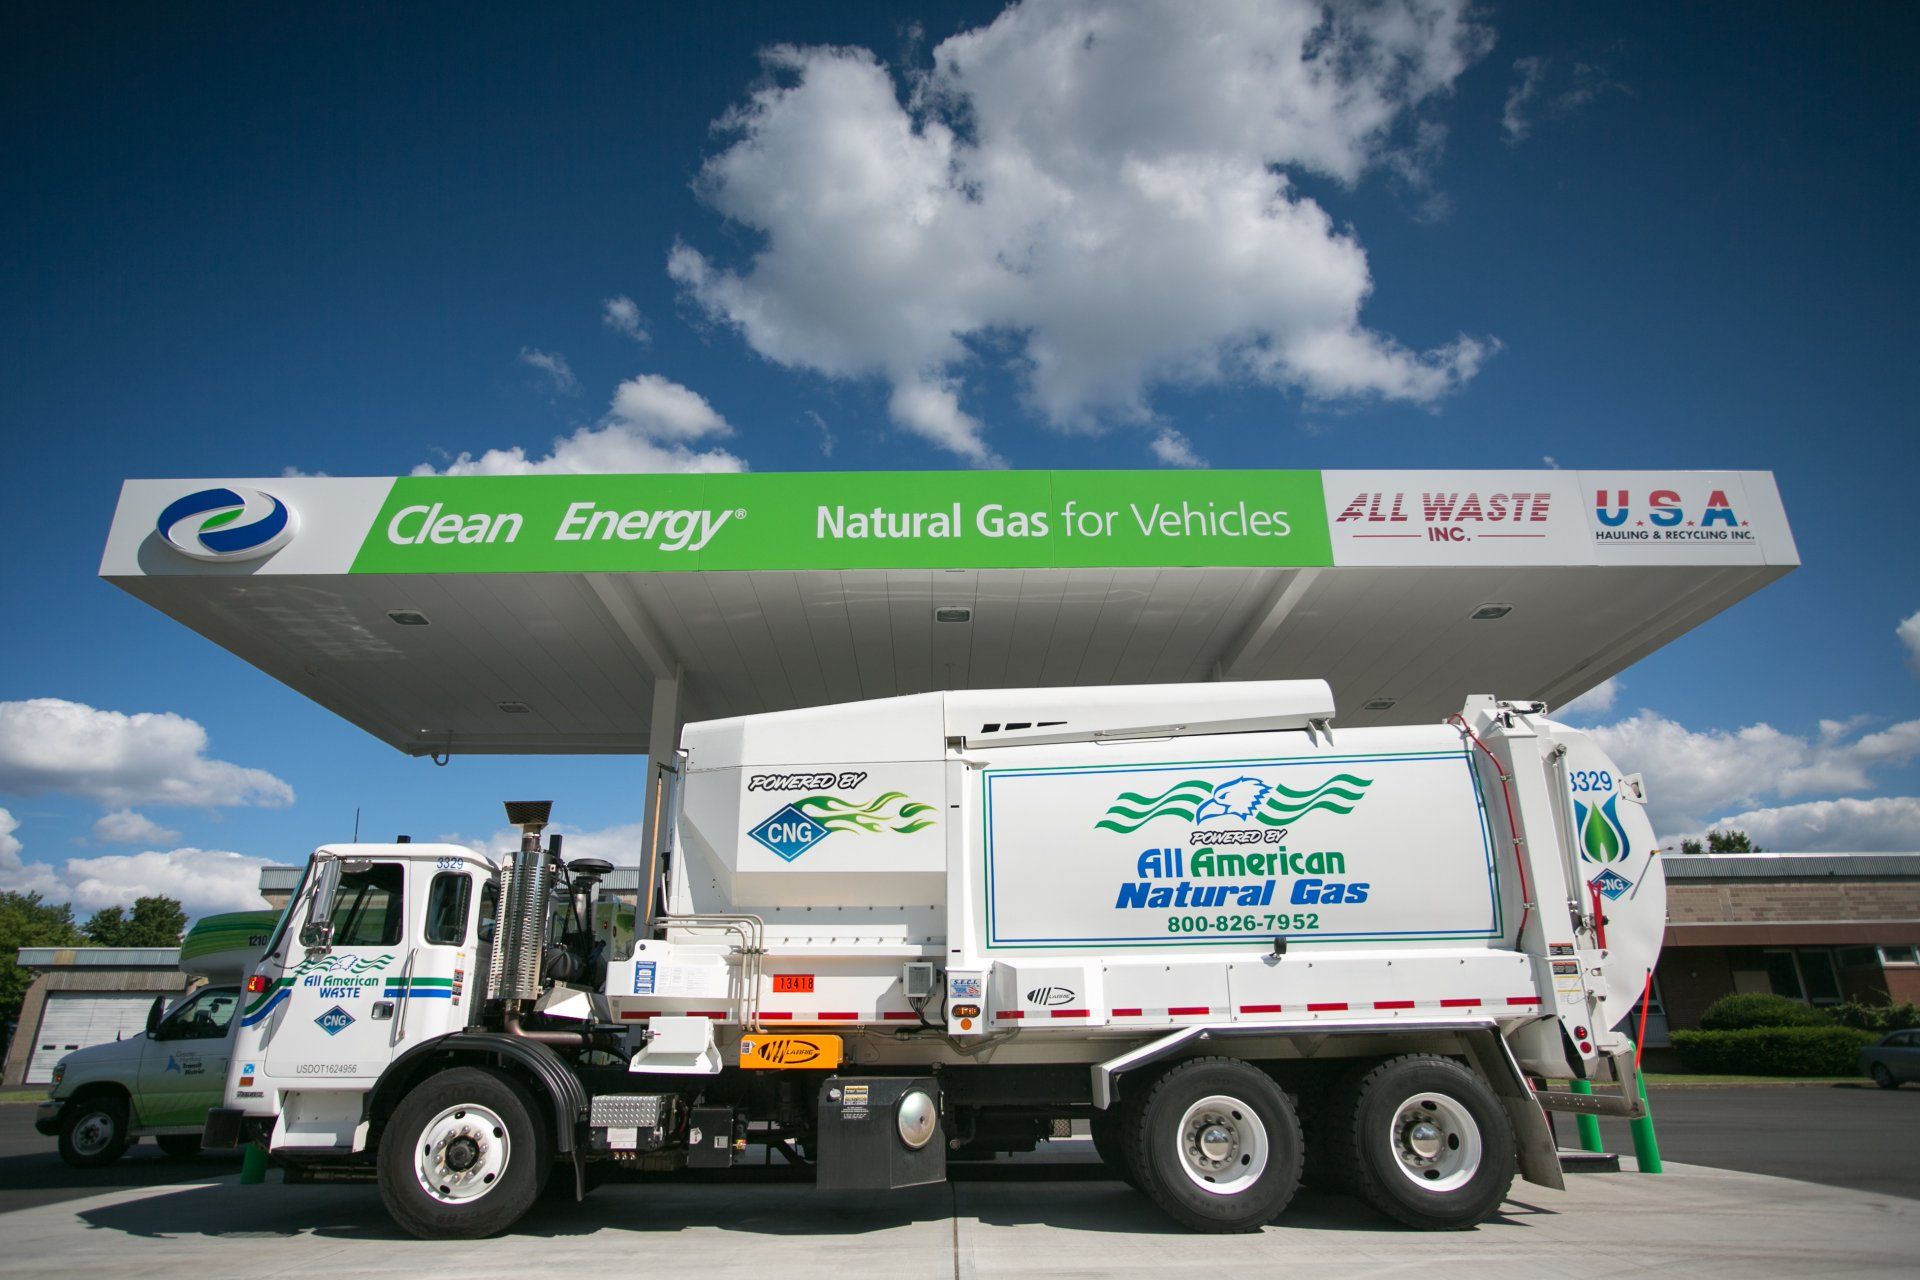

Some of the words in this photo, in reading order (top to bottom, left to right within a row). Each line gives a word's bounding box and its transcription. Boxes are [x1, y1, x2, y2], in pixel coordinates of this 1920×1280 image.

[1335, 493, 1408, 522] ALL
[1422, 493, 1551, 522] WASTE
[387, 503, 523, 545] Clean
[817, 503, 961, 539] Natural
[976, 503, 1049, 538] Gas
[1061, 501, 1119, 538] for
[1130, 501, 1291, 538] Vehicles
[1428, 527, 1471, 542] INC.
[1596, 531, 1649, 540] HAULING
[1652, 531, 1662, 540] &
[1666, 531, 1728, 540] RECYCLING
[1731, 531, 1755, 540] INC.
[748, 773, 836, 791] POWERED
[838, 772, 867, 790] BY
[767, 822, 812, 843] CNG
[1190, 830, 1263, 845] POWERED
[1263, 829, 1288, 844] BY
[437, 857, 464, 869] 3329
[1137, 848, 1183, 878] All
[1190, 846, 1346, 877] American
[1115, 880, 1276, 909] Natural
[1290, 879, 1370, 905] Gas
[1168, 913, 1319, 932] 800-826-7952
[248, 935, 268, 947] 1210
[304, 975, 321, 986] All
[323, 975, 379, 986] American
[780, 978, 814, 989] 13418
[319, 988, 361, 998] WASTE
[323, 1015, 347, 1026] CNG
[296, 1064, 358, 1074] USDOT1624956
